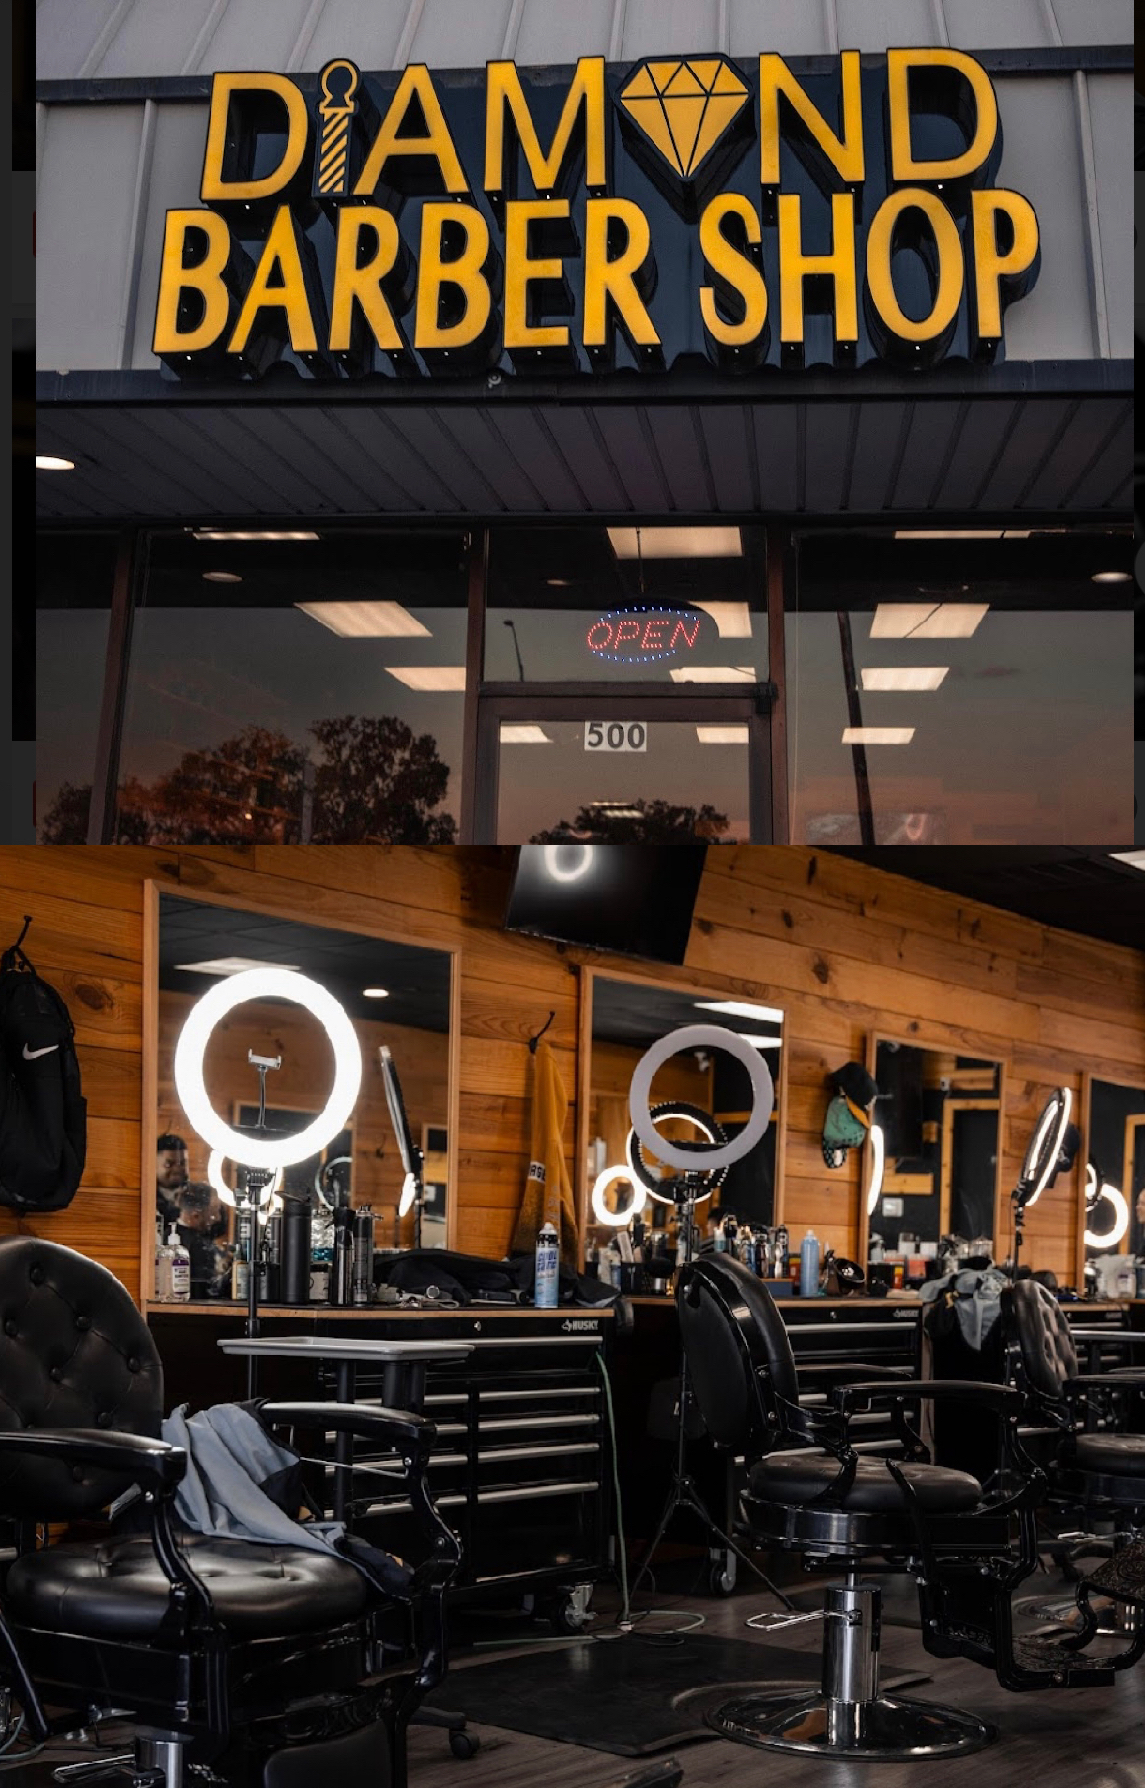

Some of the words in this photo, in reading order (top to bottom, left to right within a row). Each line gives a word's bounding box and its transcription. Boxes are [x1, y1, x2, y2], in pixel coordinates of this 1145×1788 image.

[152, 196, 662, 353] BARBER
[699, 187, 1040, 346] SHOP
[587, 620, 700, 649] OPEN
[588, 722, 645, 749] 500
[572, 1320, 599, 1331] HUSKY
